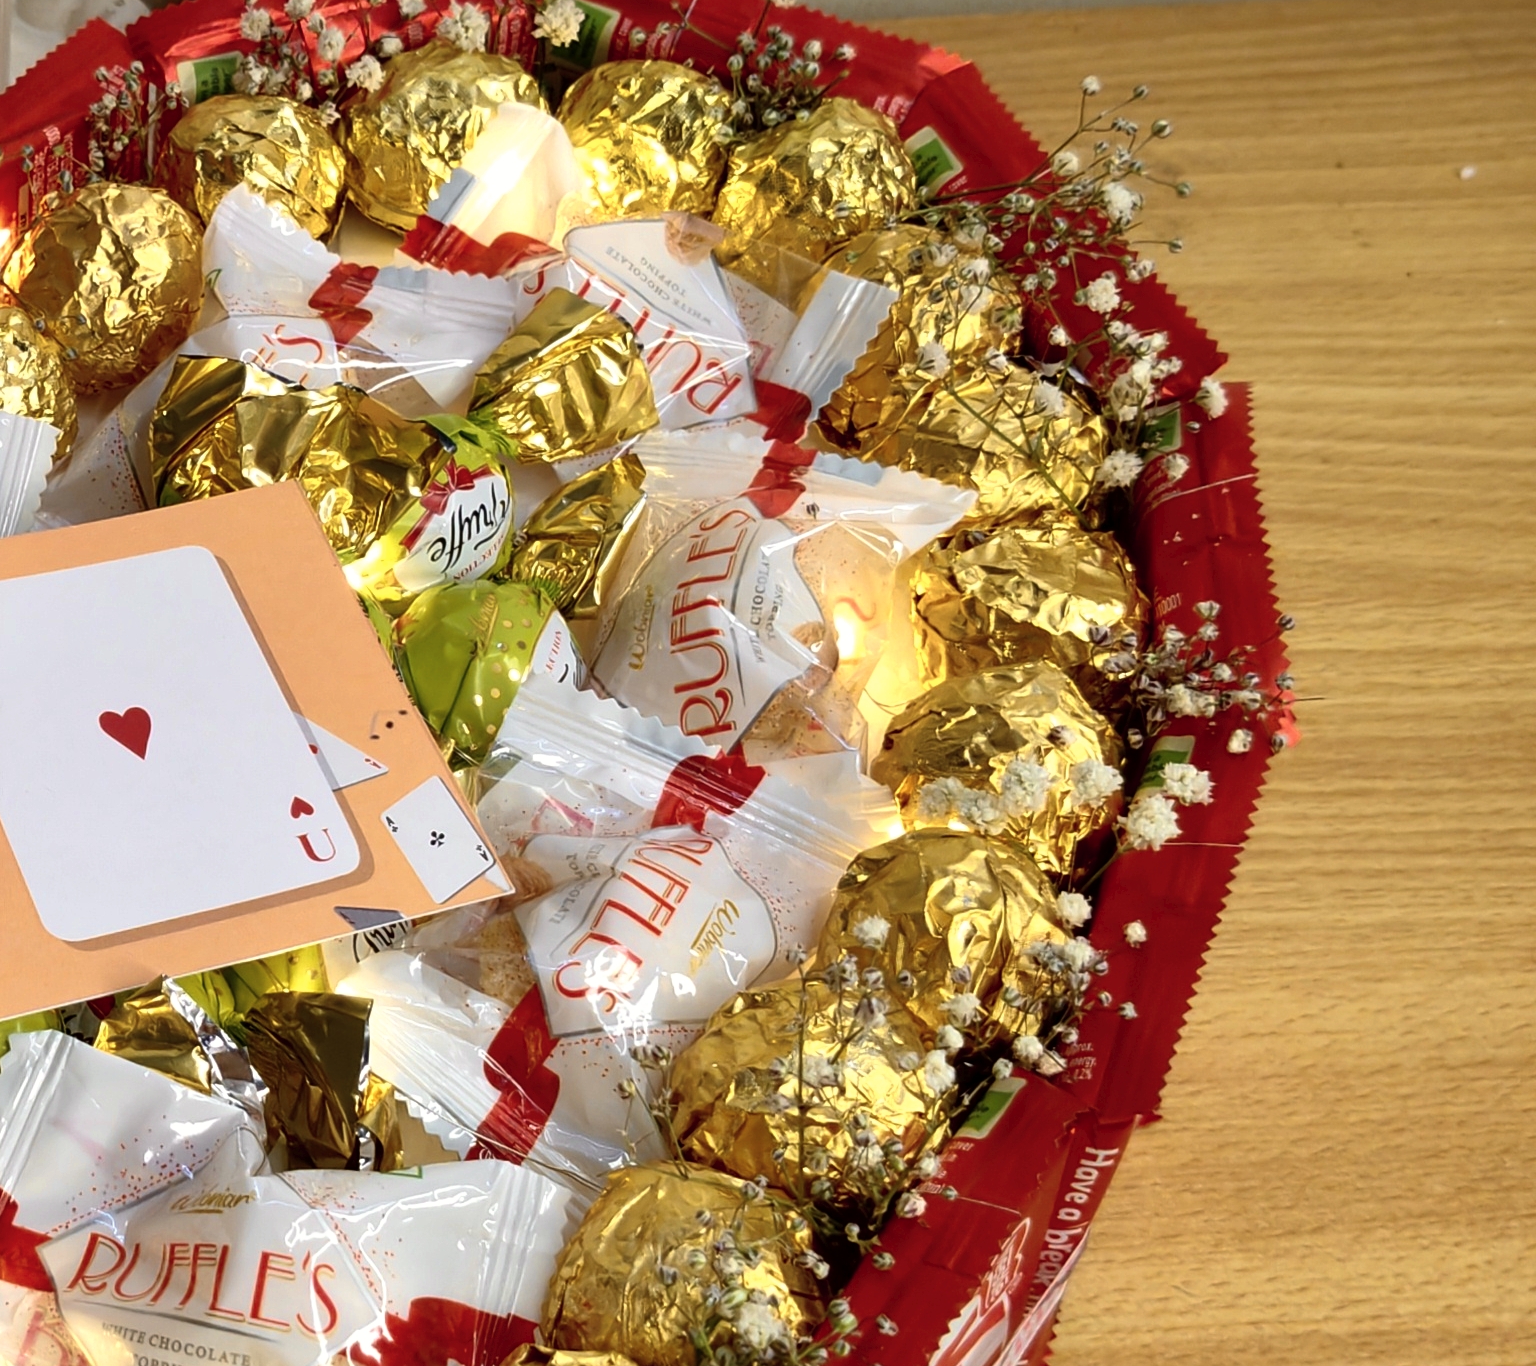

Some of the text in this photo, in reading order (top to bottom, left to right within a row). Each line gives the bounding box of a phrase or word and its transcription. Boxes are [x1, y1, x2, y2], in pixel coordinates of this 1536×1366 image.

[604, 245, 671, 302] CHOCOLATE
[639, 256, 687, 298] TOPPING
[669, 509, 757, 737] RUFFLE'S
[296, 828, 336, 862] U
[1065, 1146, 1119, 1204] Have
[1057, 1207, 1081, 1221] a
[64, 1232, 338, 1339] RUFFLE'S
